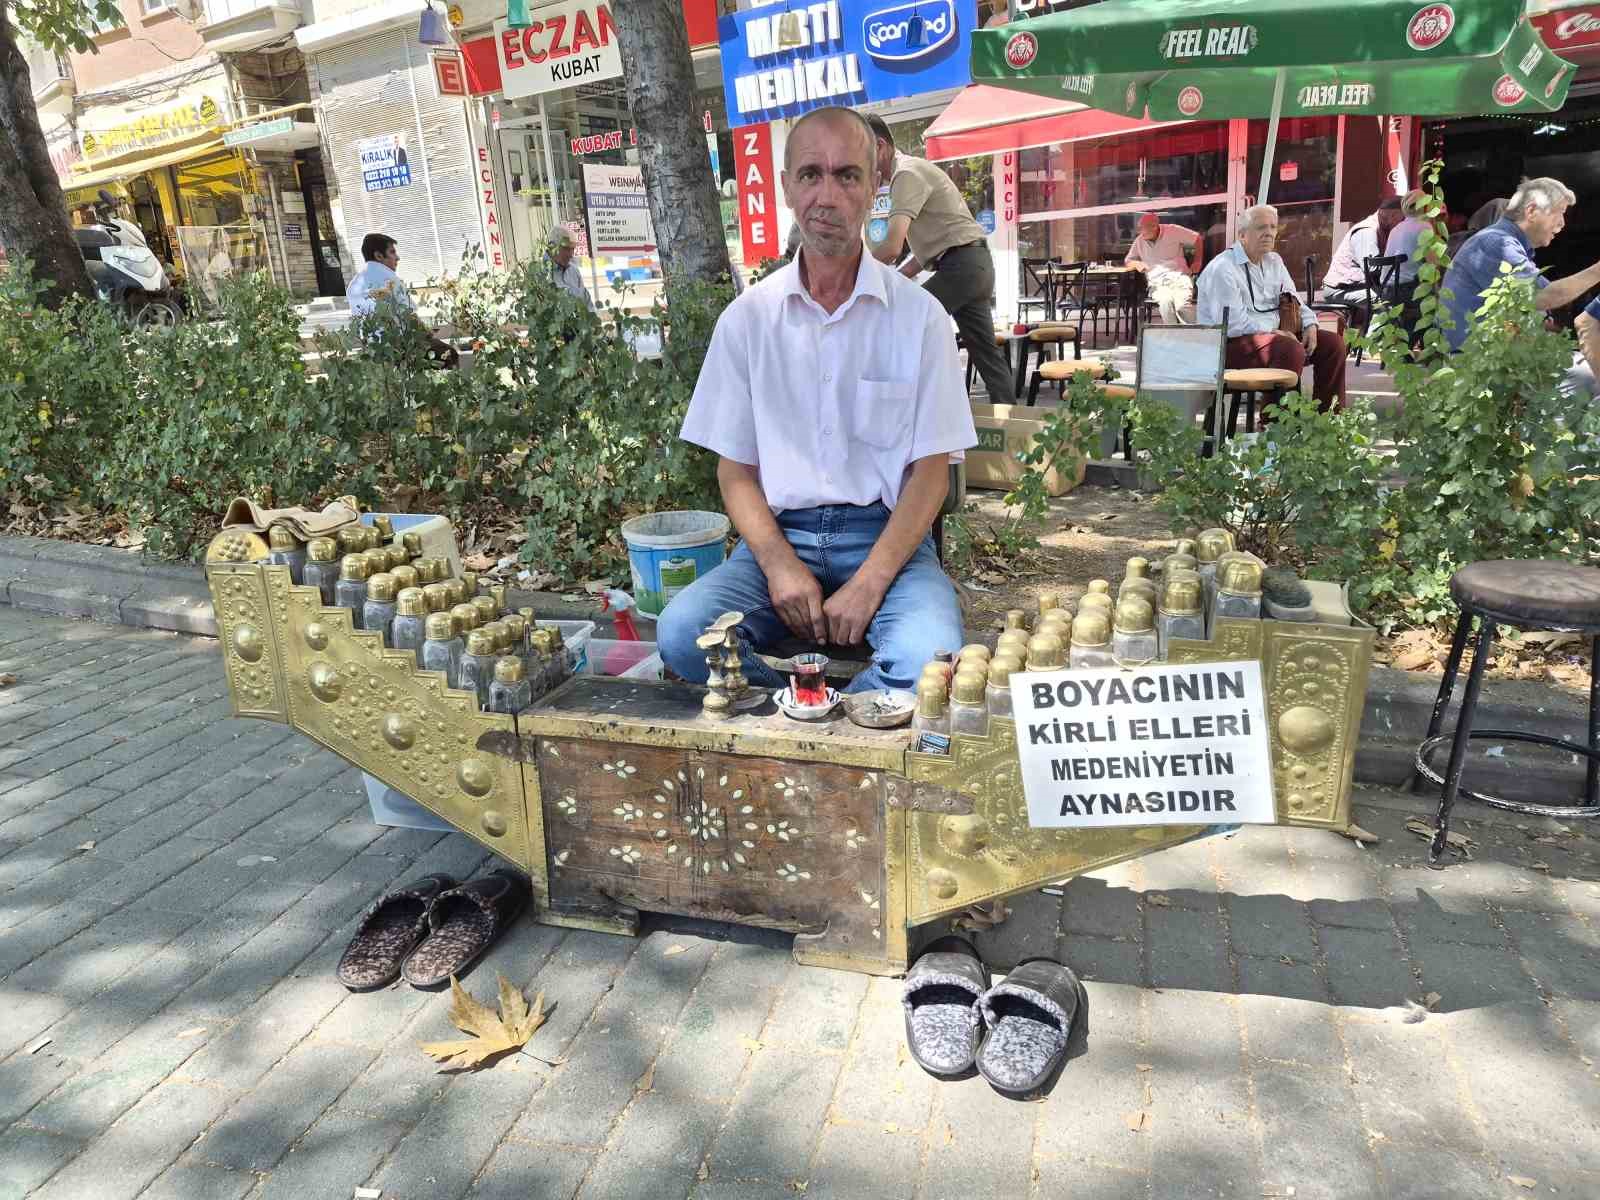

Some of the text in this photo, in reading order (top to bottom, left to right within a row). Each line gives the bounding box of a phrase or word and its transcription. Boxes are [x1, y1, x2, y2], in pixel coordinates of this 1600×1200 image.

[1166, 25, 1250, 58] FEEL REAL
[550, 54, 601, 81] KUBAT
[735, 53, 864, 113] MEDİKAL
[571, 130, 622, 155] KUBAT
[743, 132, 765, 244] ZANE
[478, 148, 503, 266] ECZANE
[1031, 671, 1245, 709] BOYACININ
[1028, 709, 1251, 745] KİRLİ ELLERİ
[1050, 747, 1235, 781] MEDENİYETİN
[1060, 789, 1237, 817] AYNASIDIR
